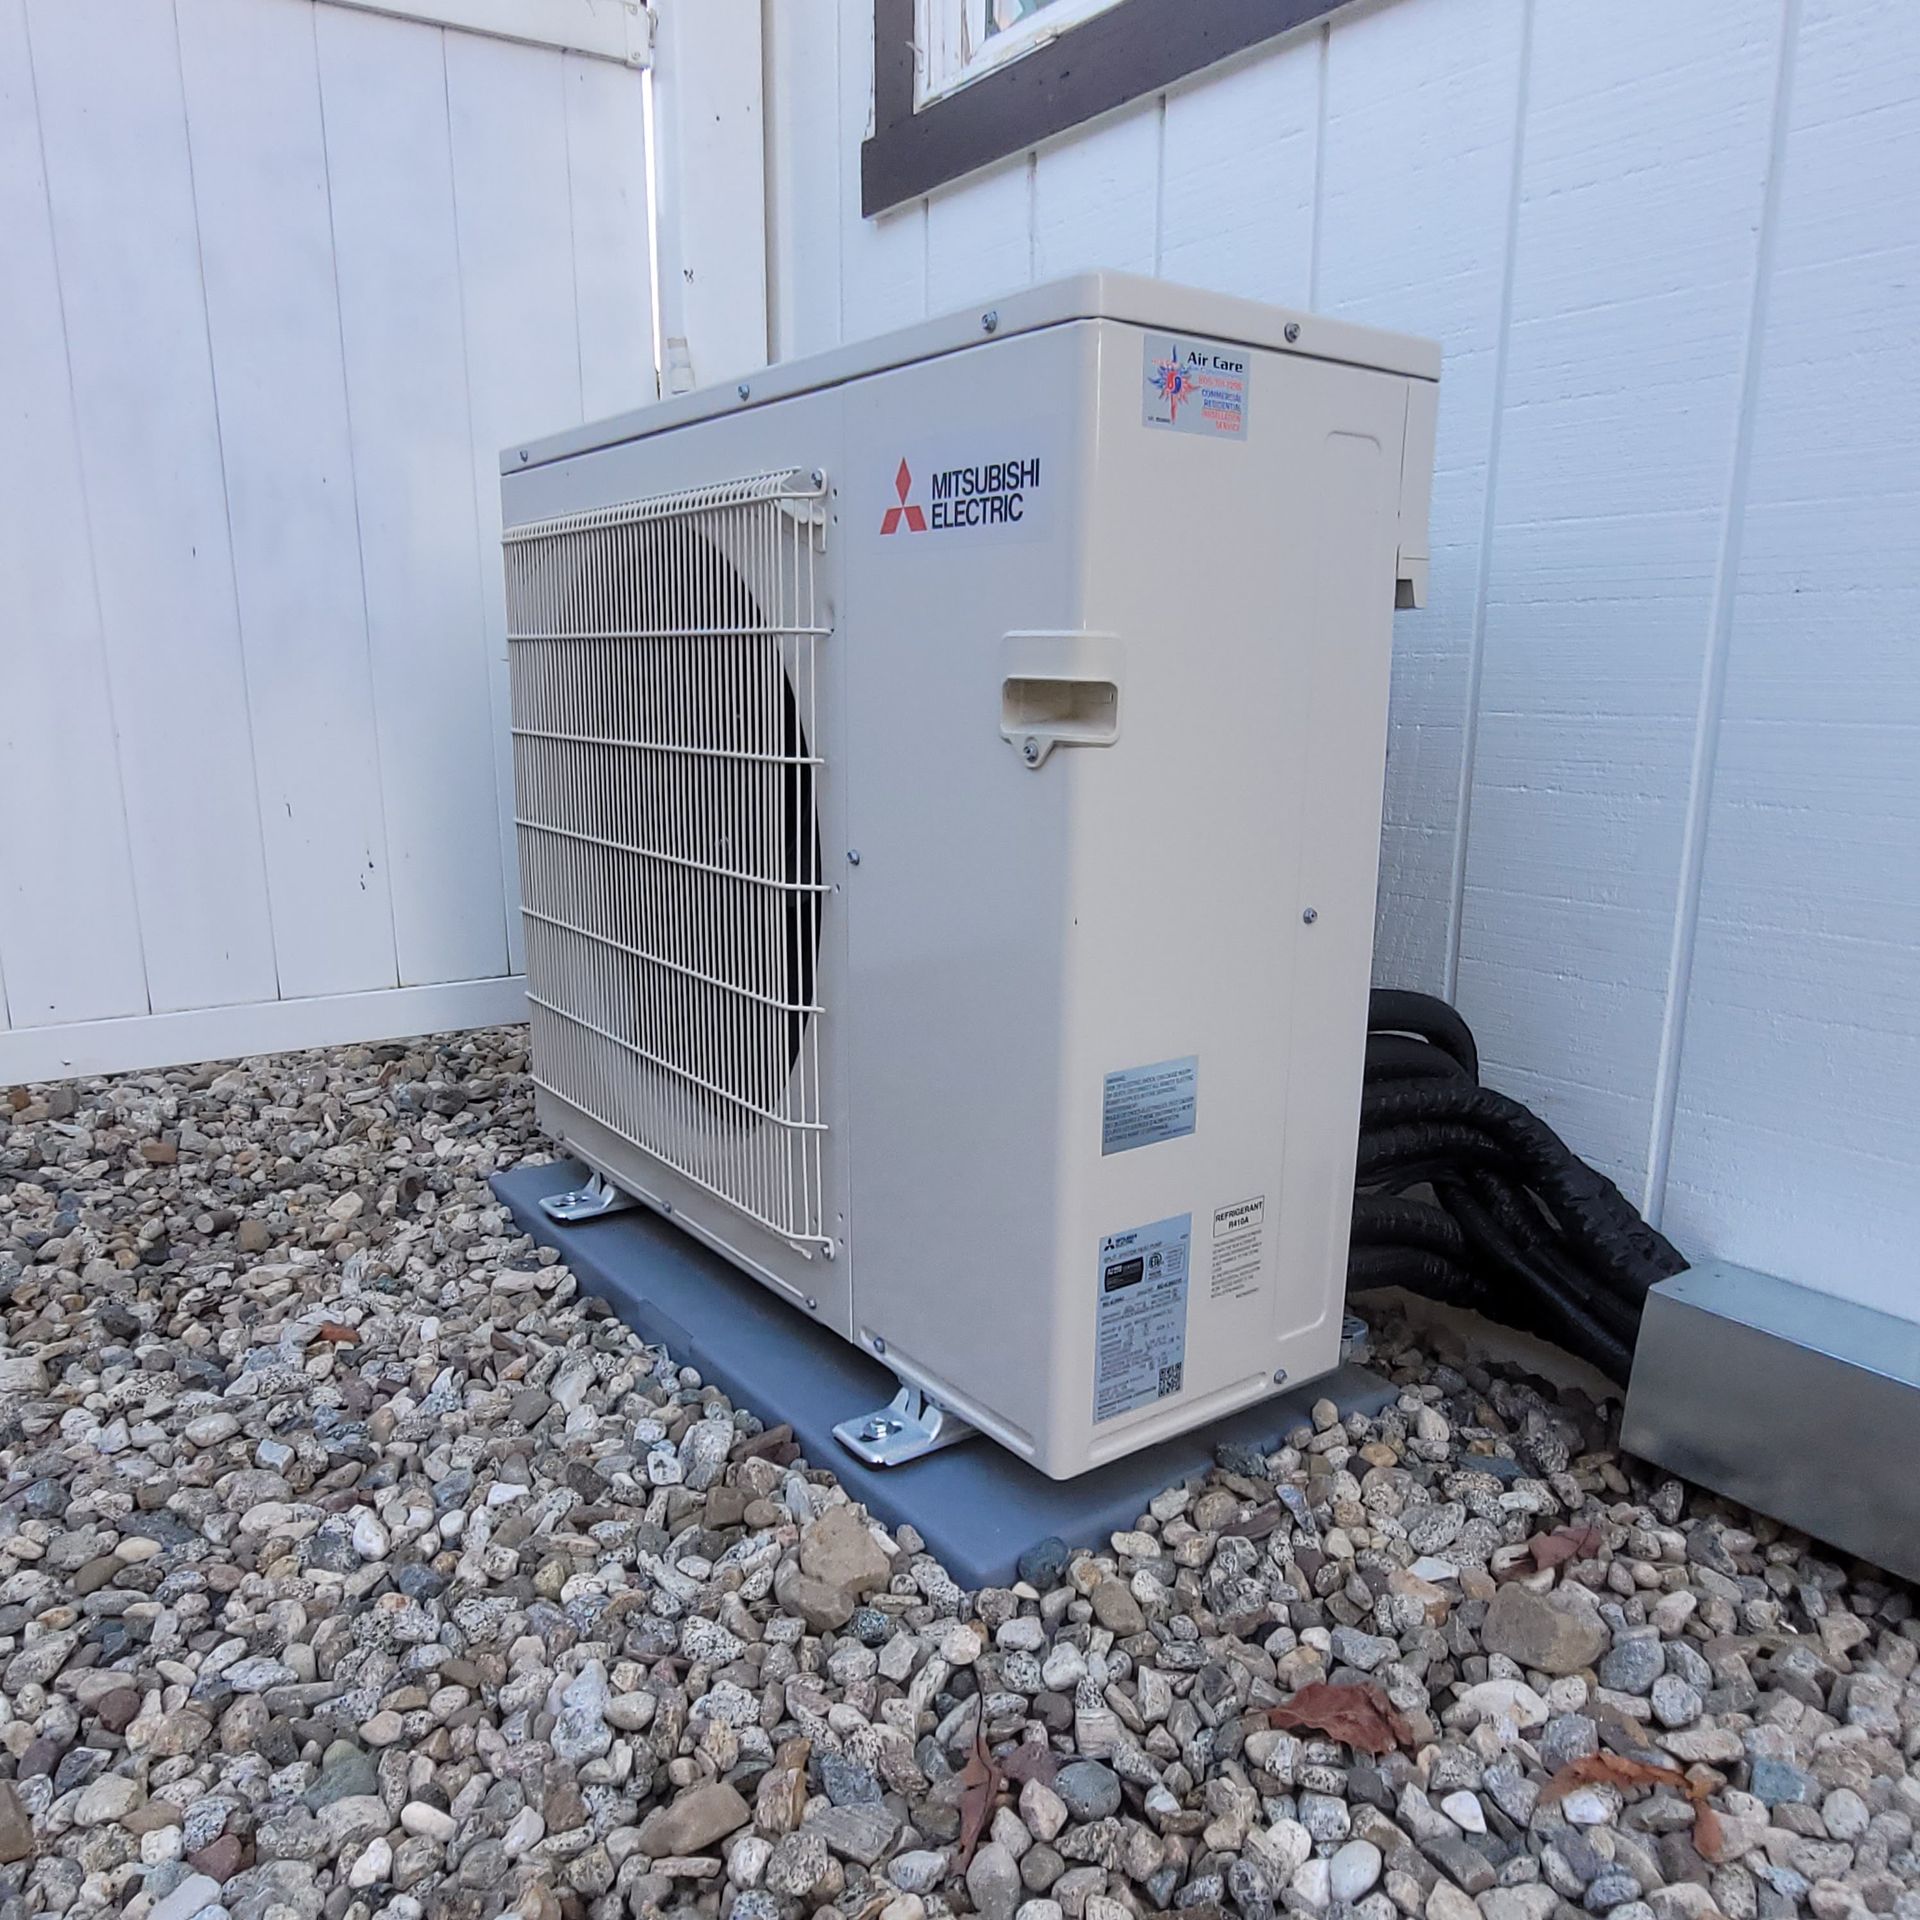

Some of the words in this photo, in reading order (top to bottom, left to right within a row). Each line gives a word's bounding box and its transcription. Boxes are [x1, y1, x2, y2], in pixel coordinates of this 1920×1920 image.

[1187, 351, 1208, 367] Air
[1213, 356, 1243, 373] Care
[932, 458, 1040, 500] MITSUBISHI
[932, 493, 1023, 530] ELECTRIC
[1215, 1201, 1263, 1222] REFRIGERANT
